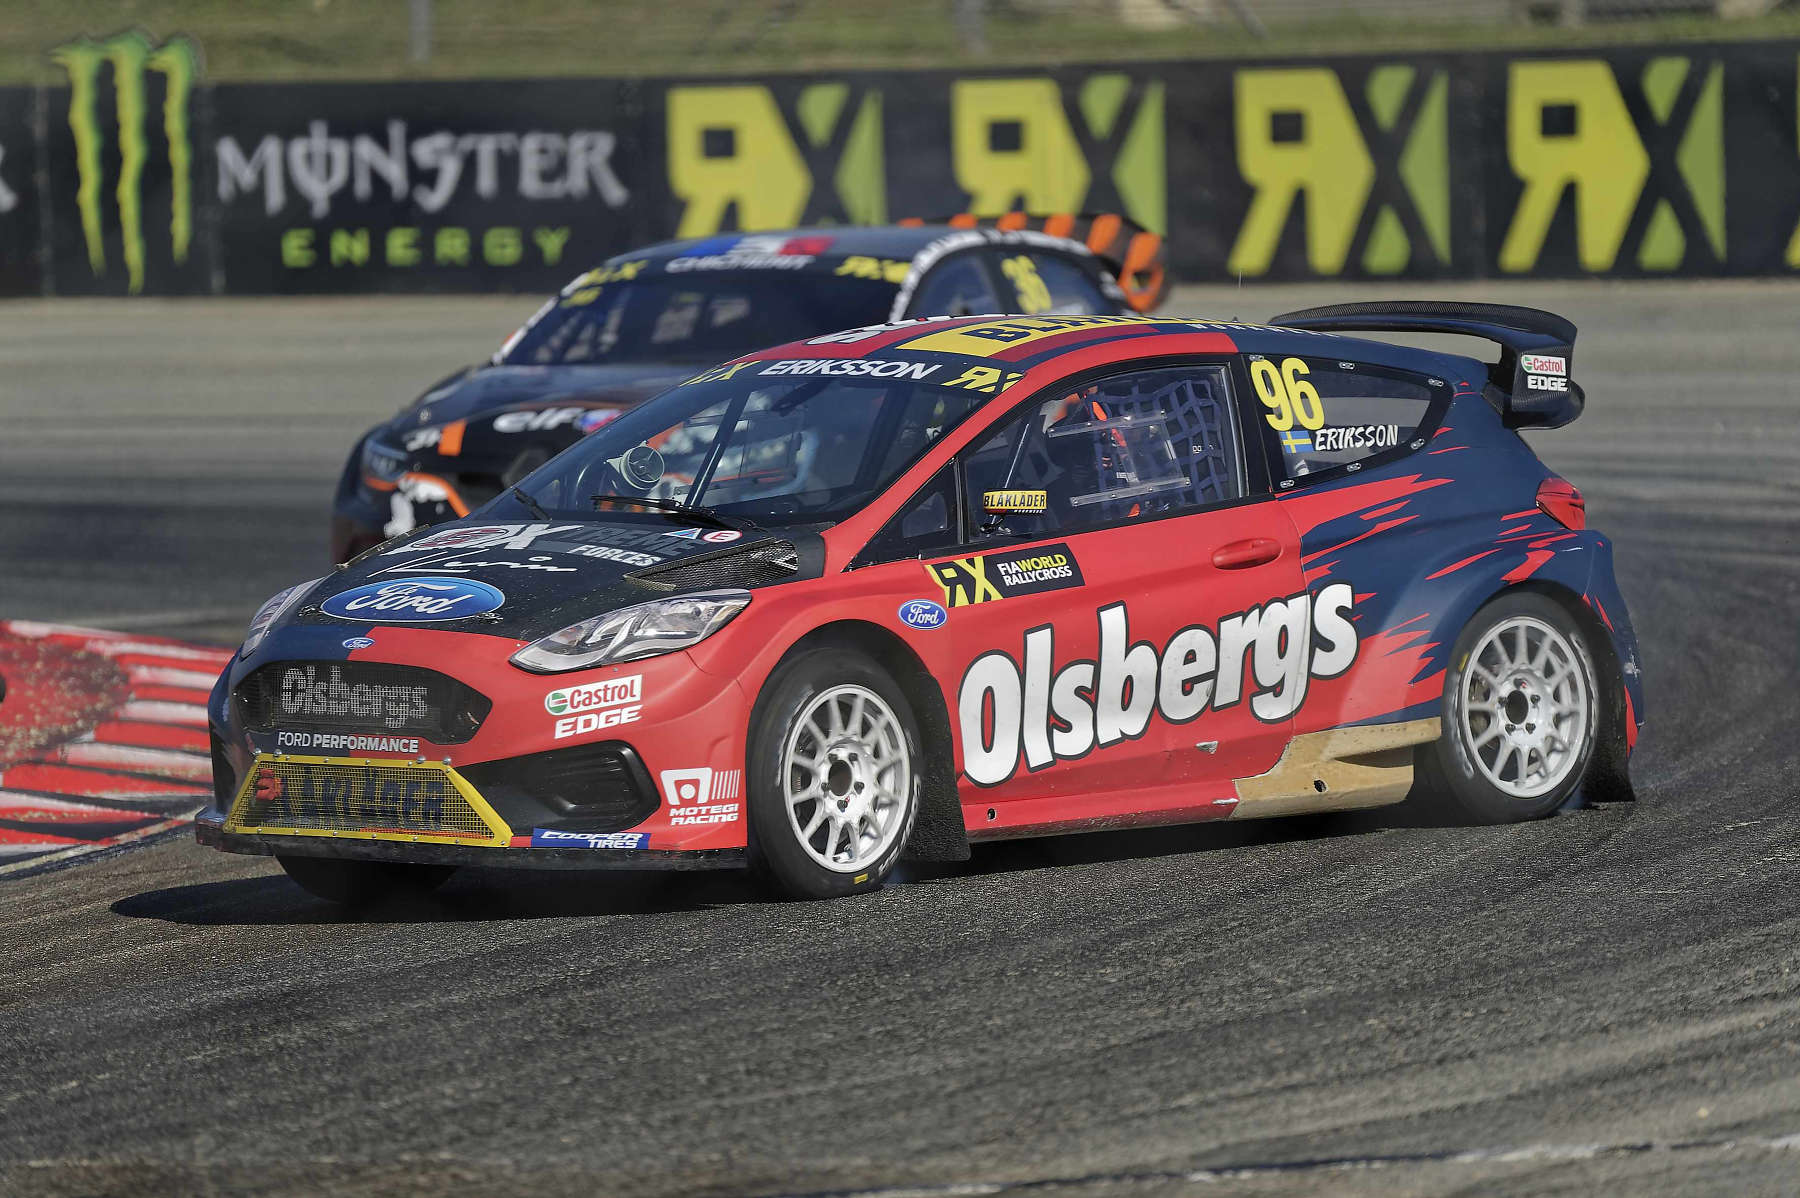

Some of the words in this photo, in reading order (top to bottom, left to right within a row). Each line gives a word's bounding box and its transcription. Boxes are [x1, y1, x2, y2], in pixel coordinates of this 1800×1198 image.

[216, 118, 629, 214] MONSTER
[281, 227, 571, 267] ENERGY
[757, 359, 943, 380] ERIKSSON
[1533, 357, 1564, 373] Castrol
[1250, 357, 1324, 431] 96
[1527, 375, 1569, 392] EDGE
[1315, 424, 1399, 451] ERIKSSON
[566, 544, 663, 567] FORCES
[1002, 565, 1073, 587] RALLYCROSS
[342, 581, 478, 616] Ford
[905, 602, 942, 626] Ford
[569, 679, 637, 710] Castrol
[957, 580, 1360, 788] Olsbergs
[280, 665, 428, 729] Olsbergs
[554, 704, 643, 740] EDGE
[277, 731, 311, 747] FORD
[312, 734, 419, 753] PERFORMANCE
[669, 803, 740, 818] MOTEGI
[670, 812, 739, 826] RACING
[540, 830, 644, 841] COOPER
[587, 838, 639, 850] TIRES
